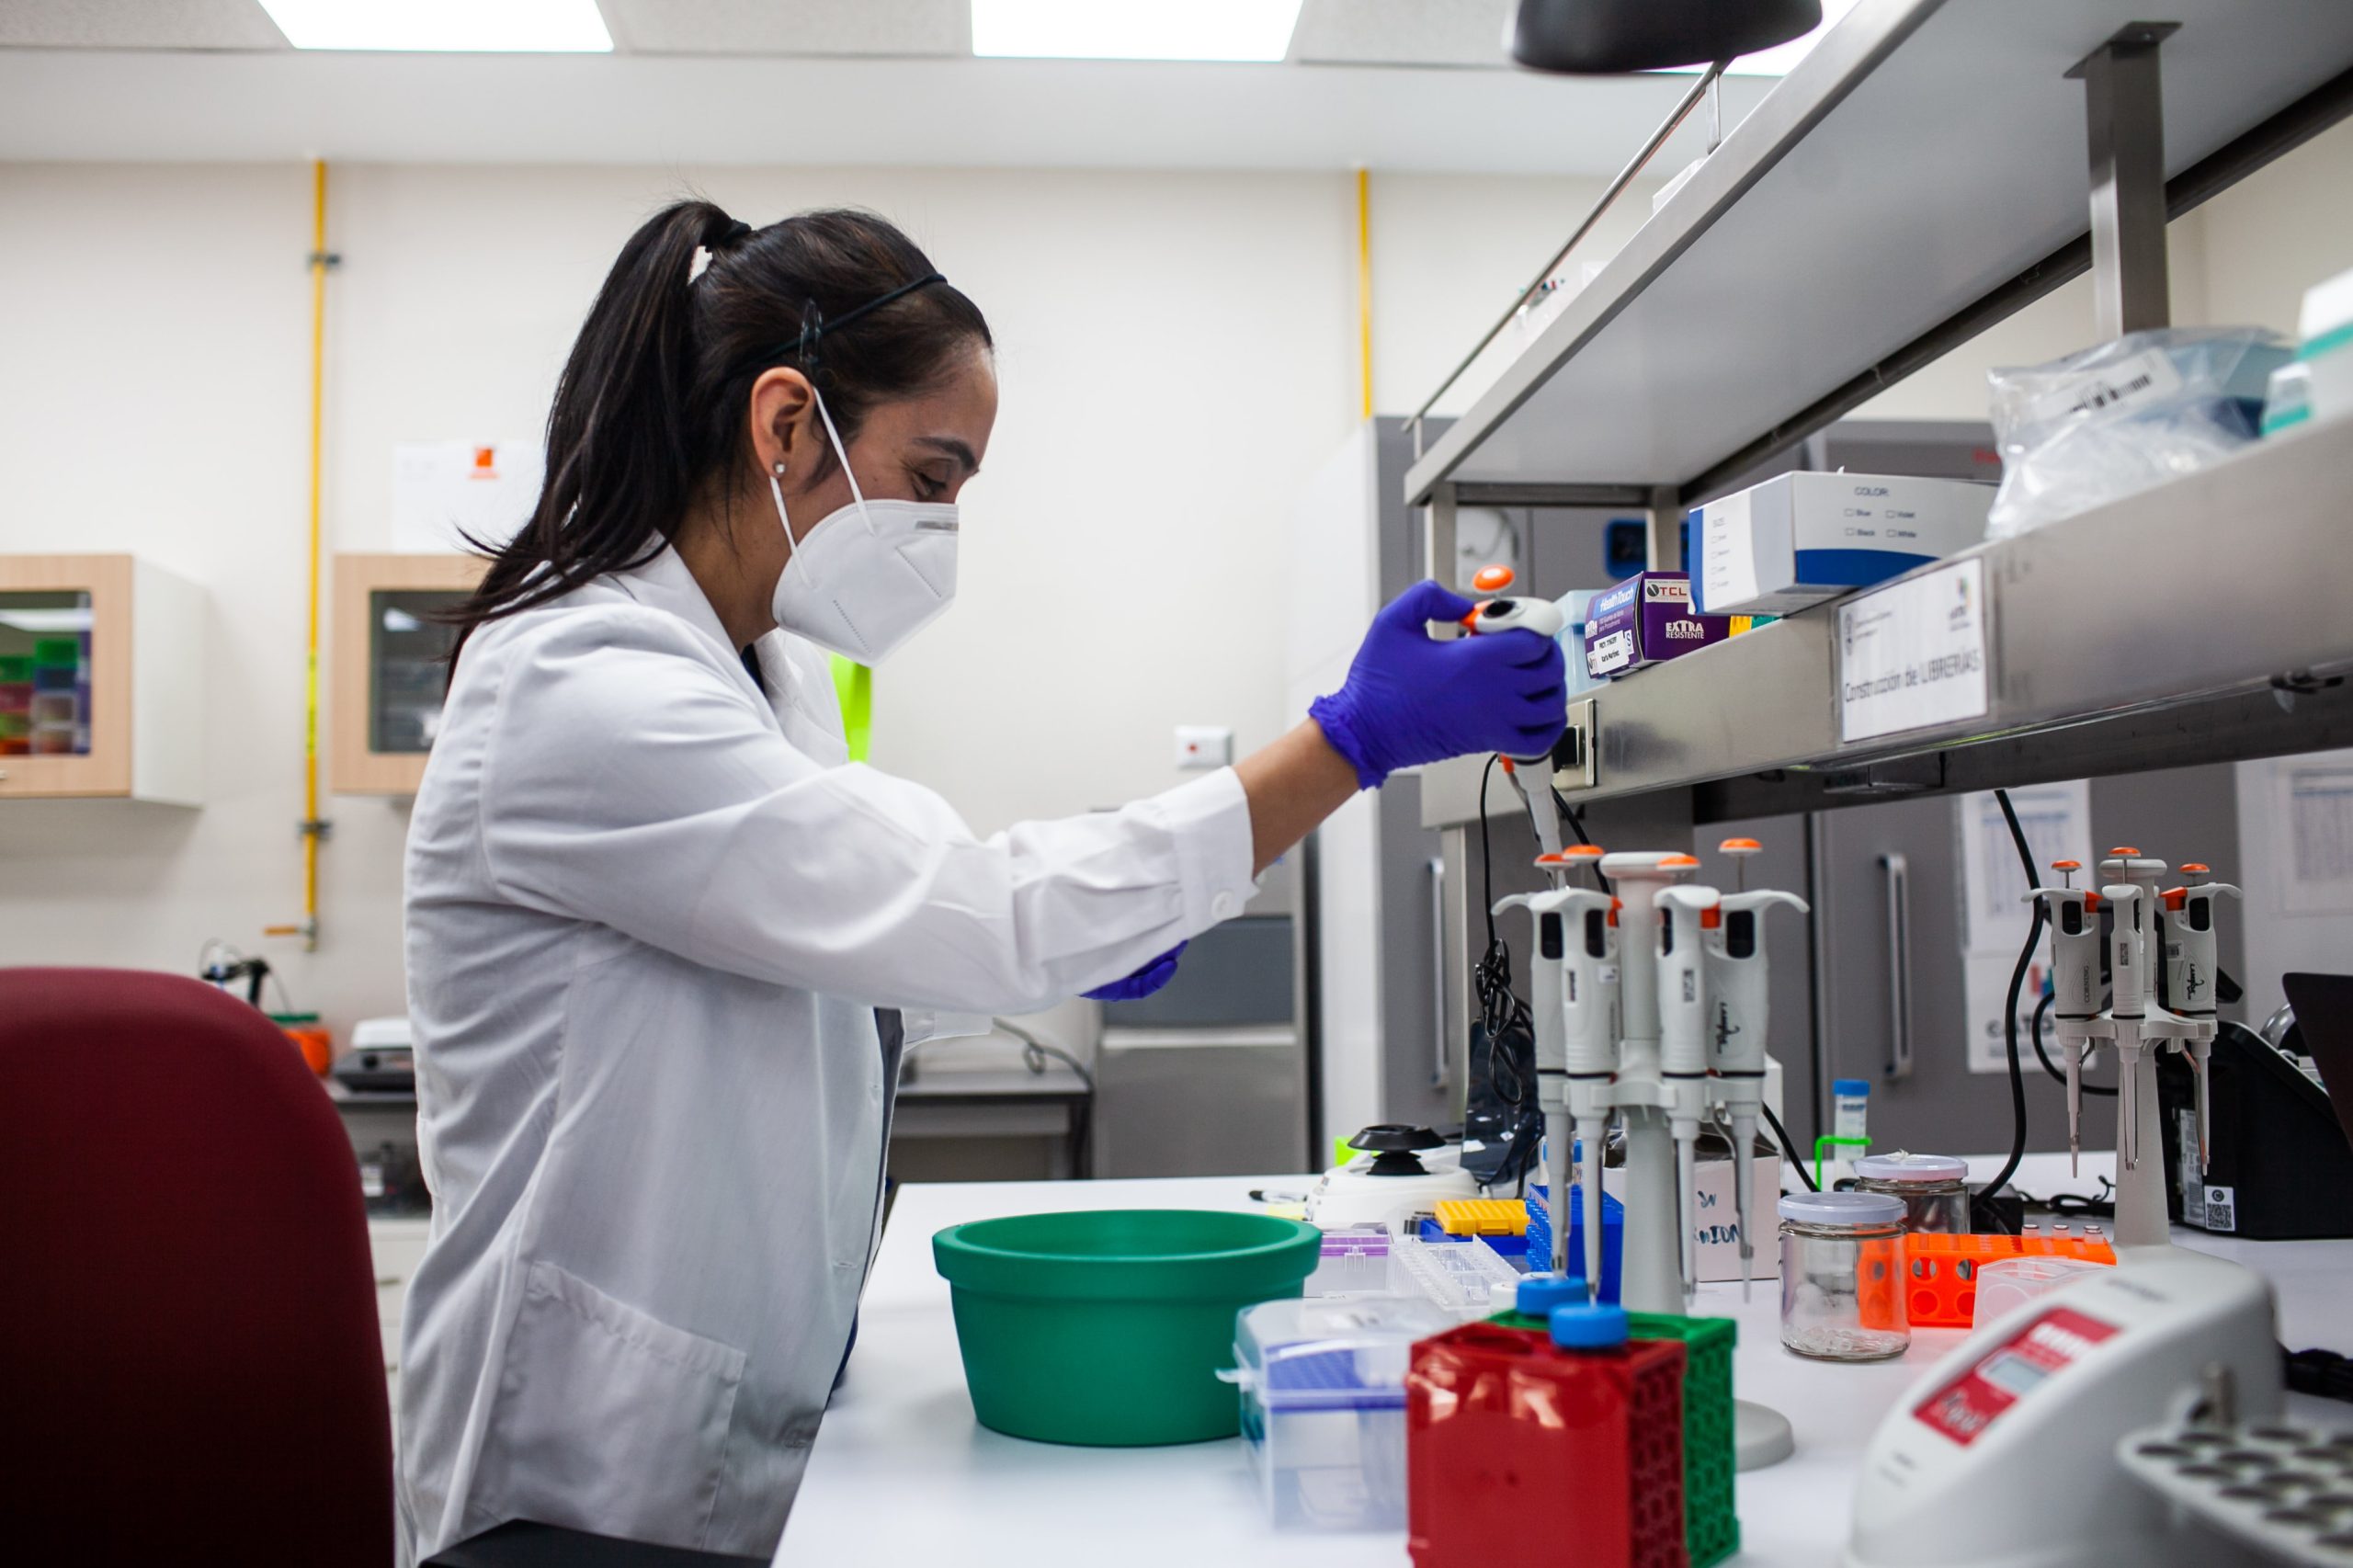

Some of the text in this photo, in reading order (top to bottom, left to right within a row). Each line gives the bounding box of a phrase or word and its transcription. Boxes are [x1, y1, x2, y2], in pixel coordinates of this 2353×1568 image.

[1659, 586, 1688, 597] TCL
[1665, 619, 1704, 632] EXTRA
[1626, 632, 1631, 647] S
